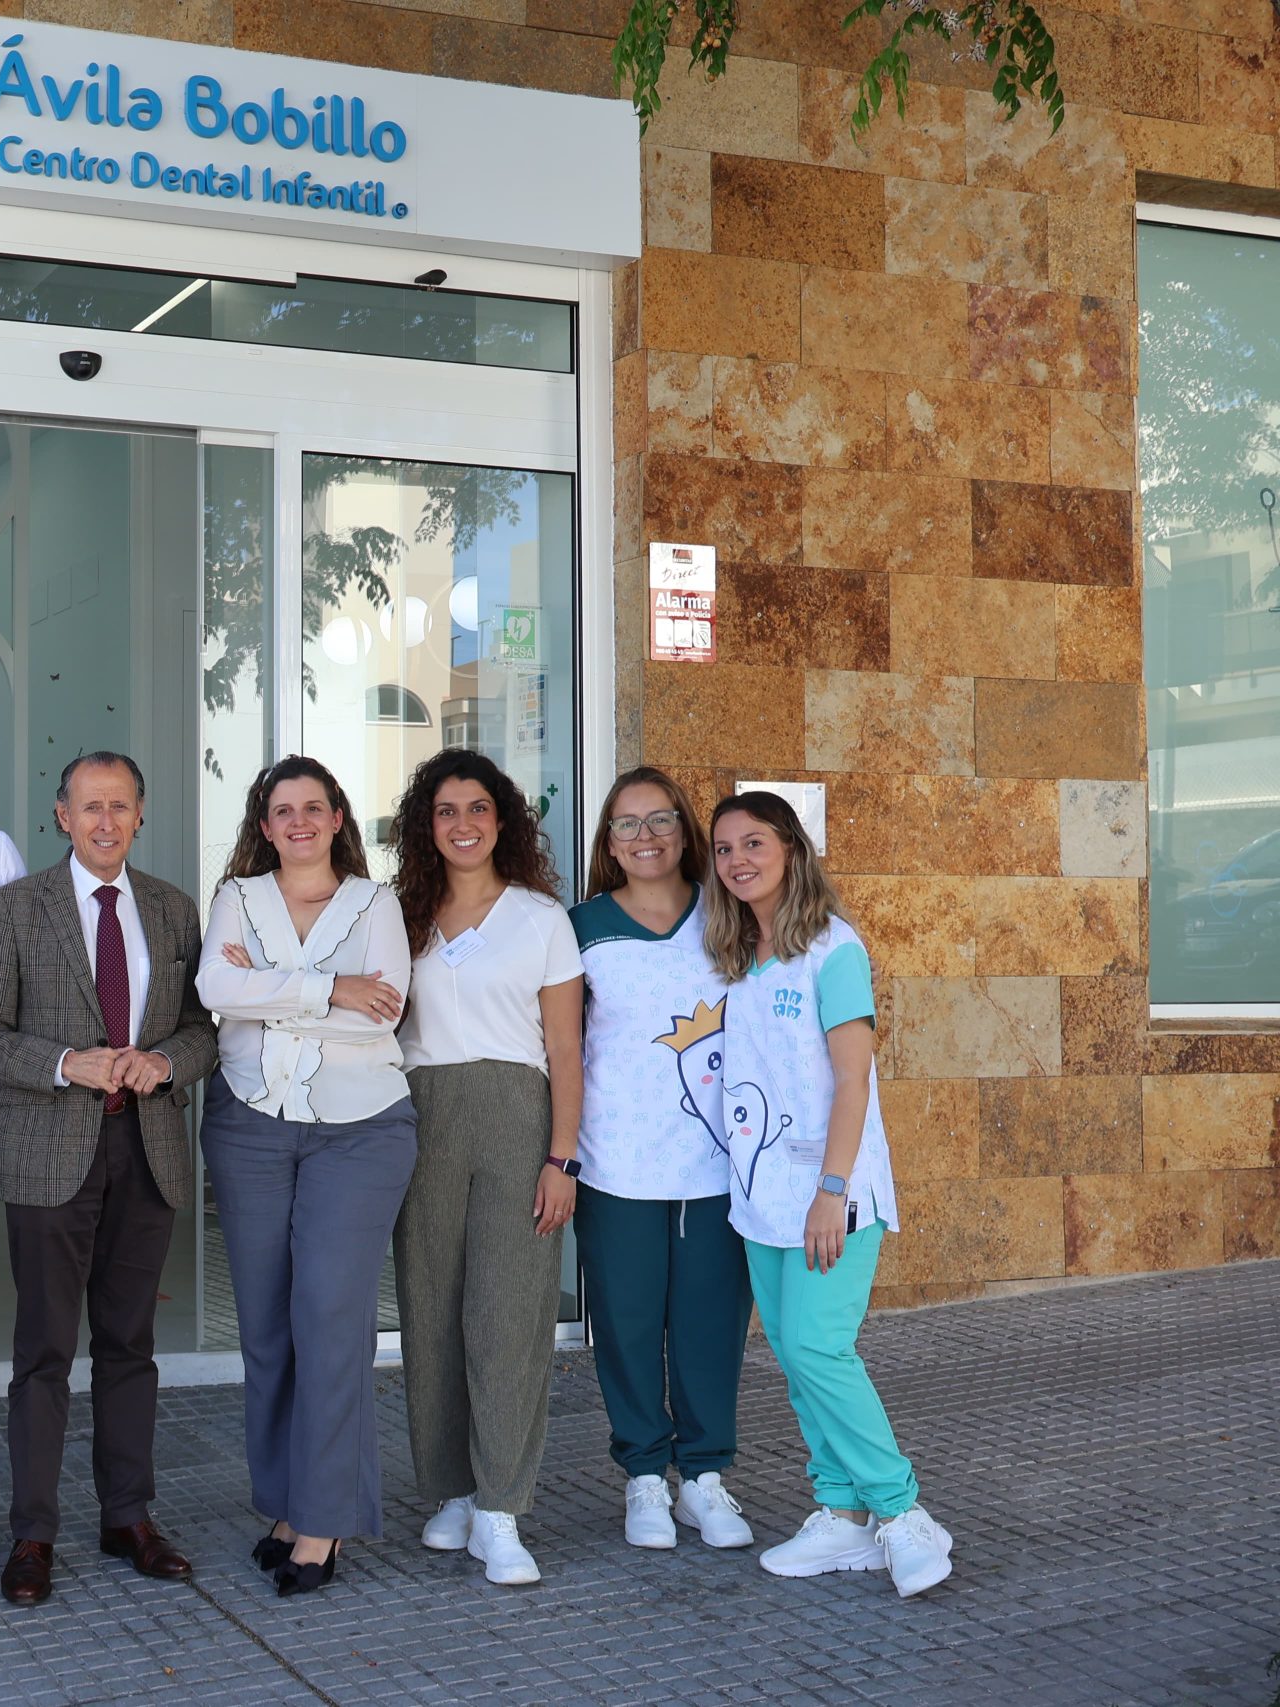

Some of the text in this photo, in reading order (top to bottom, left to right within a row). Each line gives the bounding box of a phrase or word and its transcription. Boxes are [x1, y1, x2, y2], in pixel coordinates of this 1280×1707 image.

[185, 75, 406, 163] Bobillo
[131, 151, 252, 201] Dental
[262, 167, 387, 217] Infantil
[655, 592, 711, 610] Alarma
[504, 646, 534, 659] DESA
